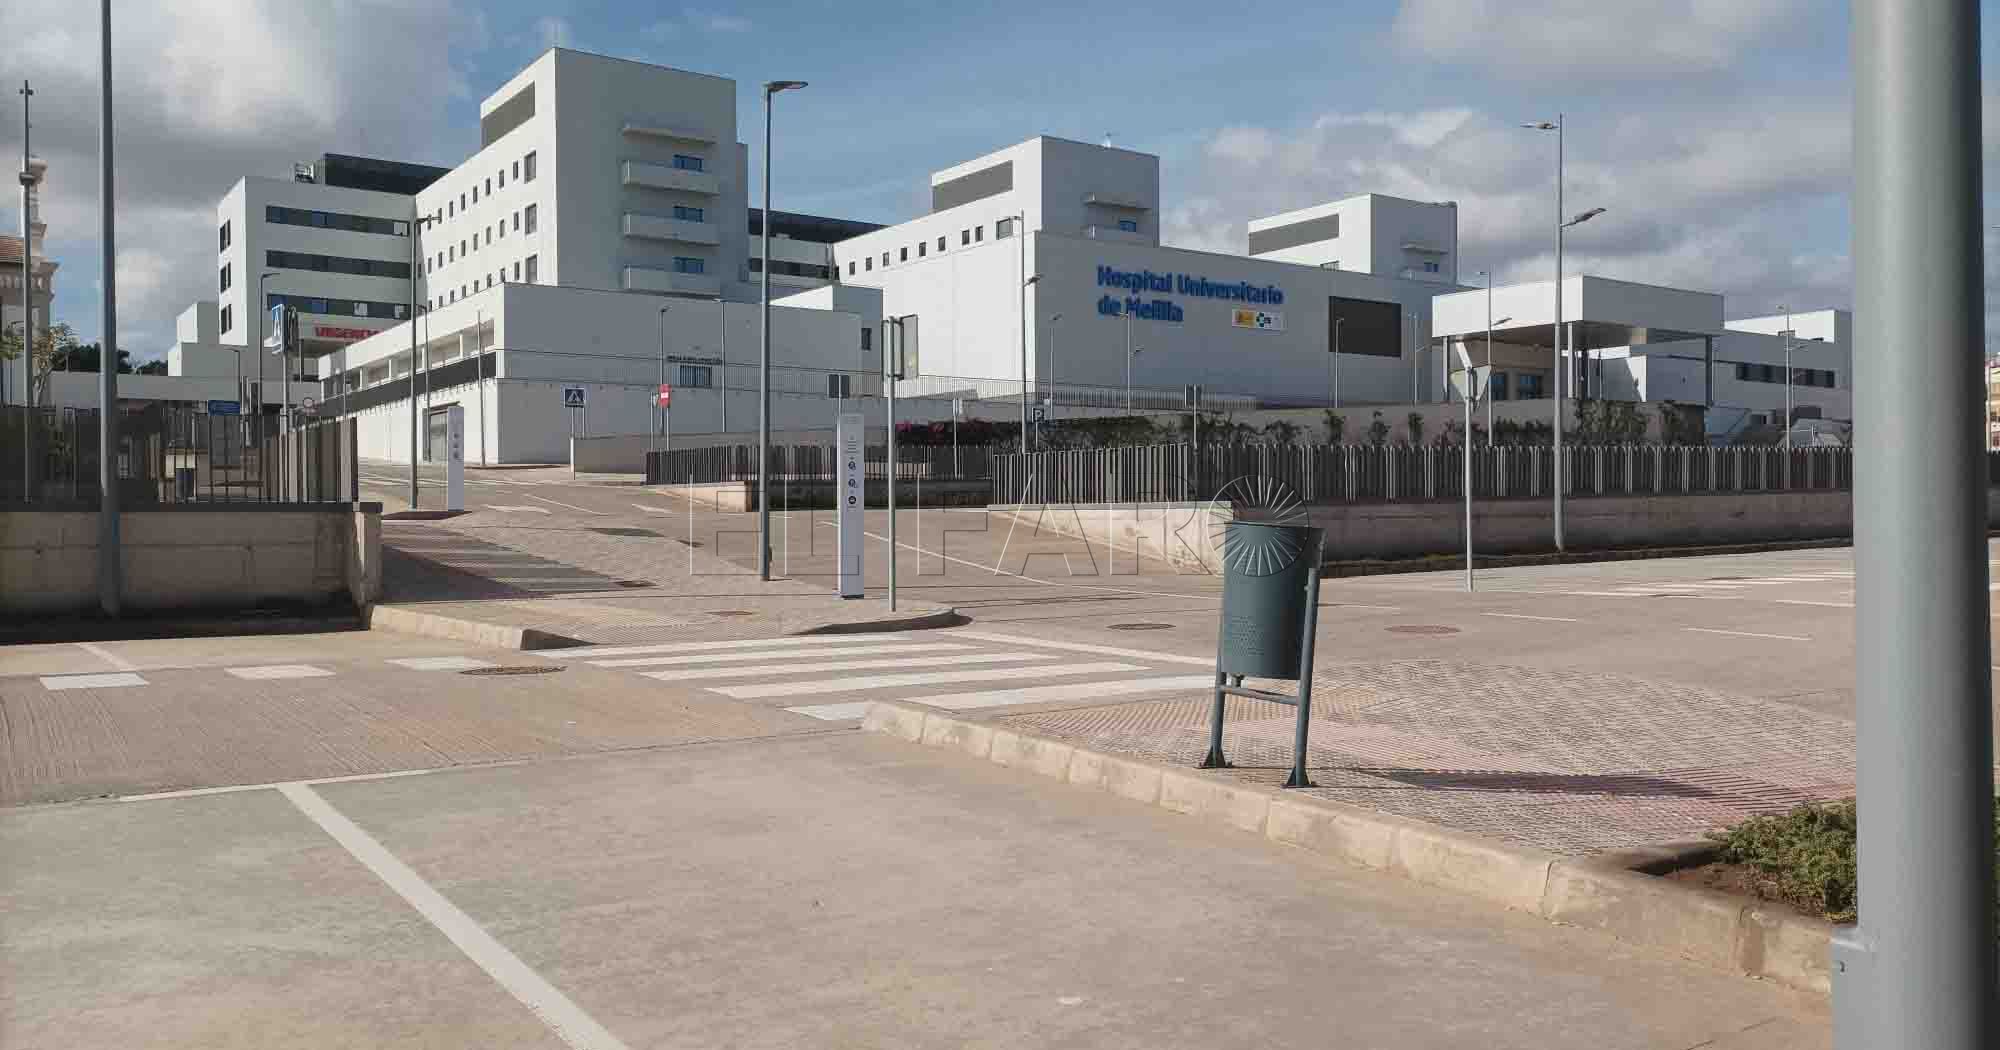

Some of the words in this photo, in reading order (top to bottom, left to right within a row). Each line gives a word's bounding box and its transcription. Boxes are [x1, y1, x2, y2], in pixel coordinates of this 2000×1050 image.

[1097, 265, 1174, 294] Hospital
[1177, 273, 1284, 305] Universitario
[1097, 295, 1122, 317] de
[1126, 296, 1184, 323] Melilla
